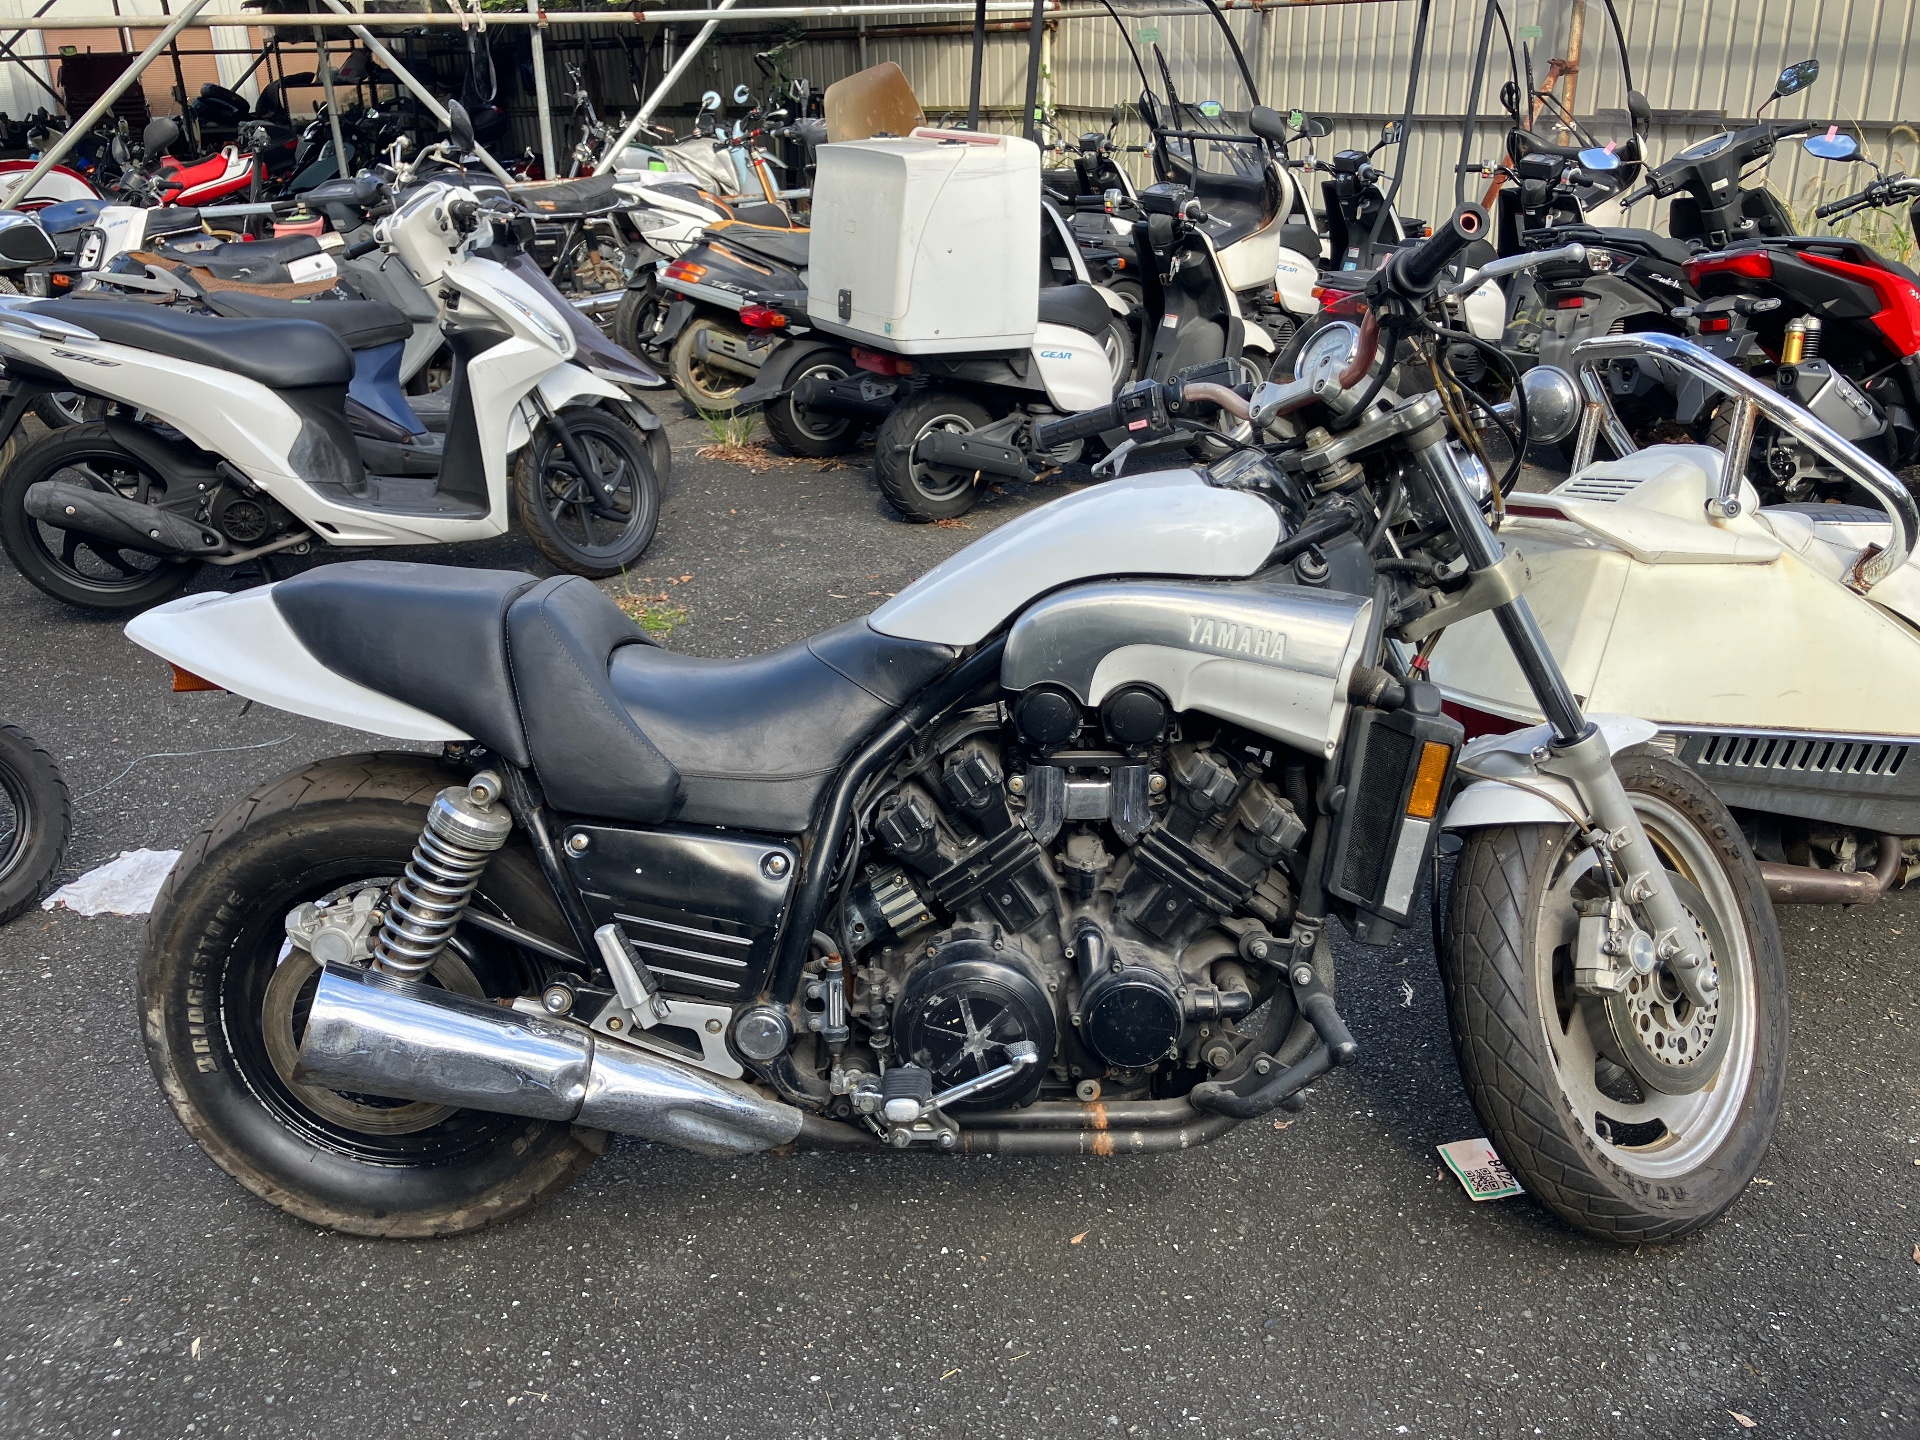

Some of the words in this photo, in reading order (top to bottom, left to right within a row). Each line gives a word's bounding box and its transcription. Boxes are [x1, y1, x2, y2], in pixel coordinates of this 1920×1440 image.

[1277, 264, 1298, 273] GEAR
[1040, 350, 1073, 360] GEAR
[1188, 615, 1288, 660] YAMAHA
[187, 890, 244, 1074] BRIDGESTONE
[1487, 1159, 1516, 1189] 8422
